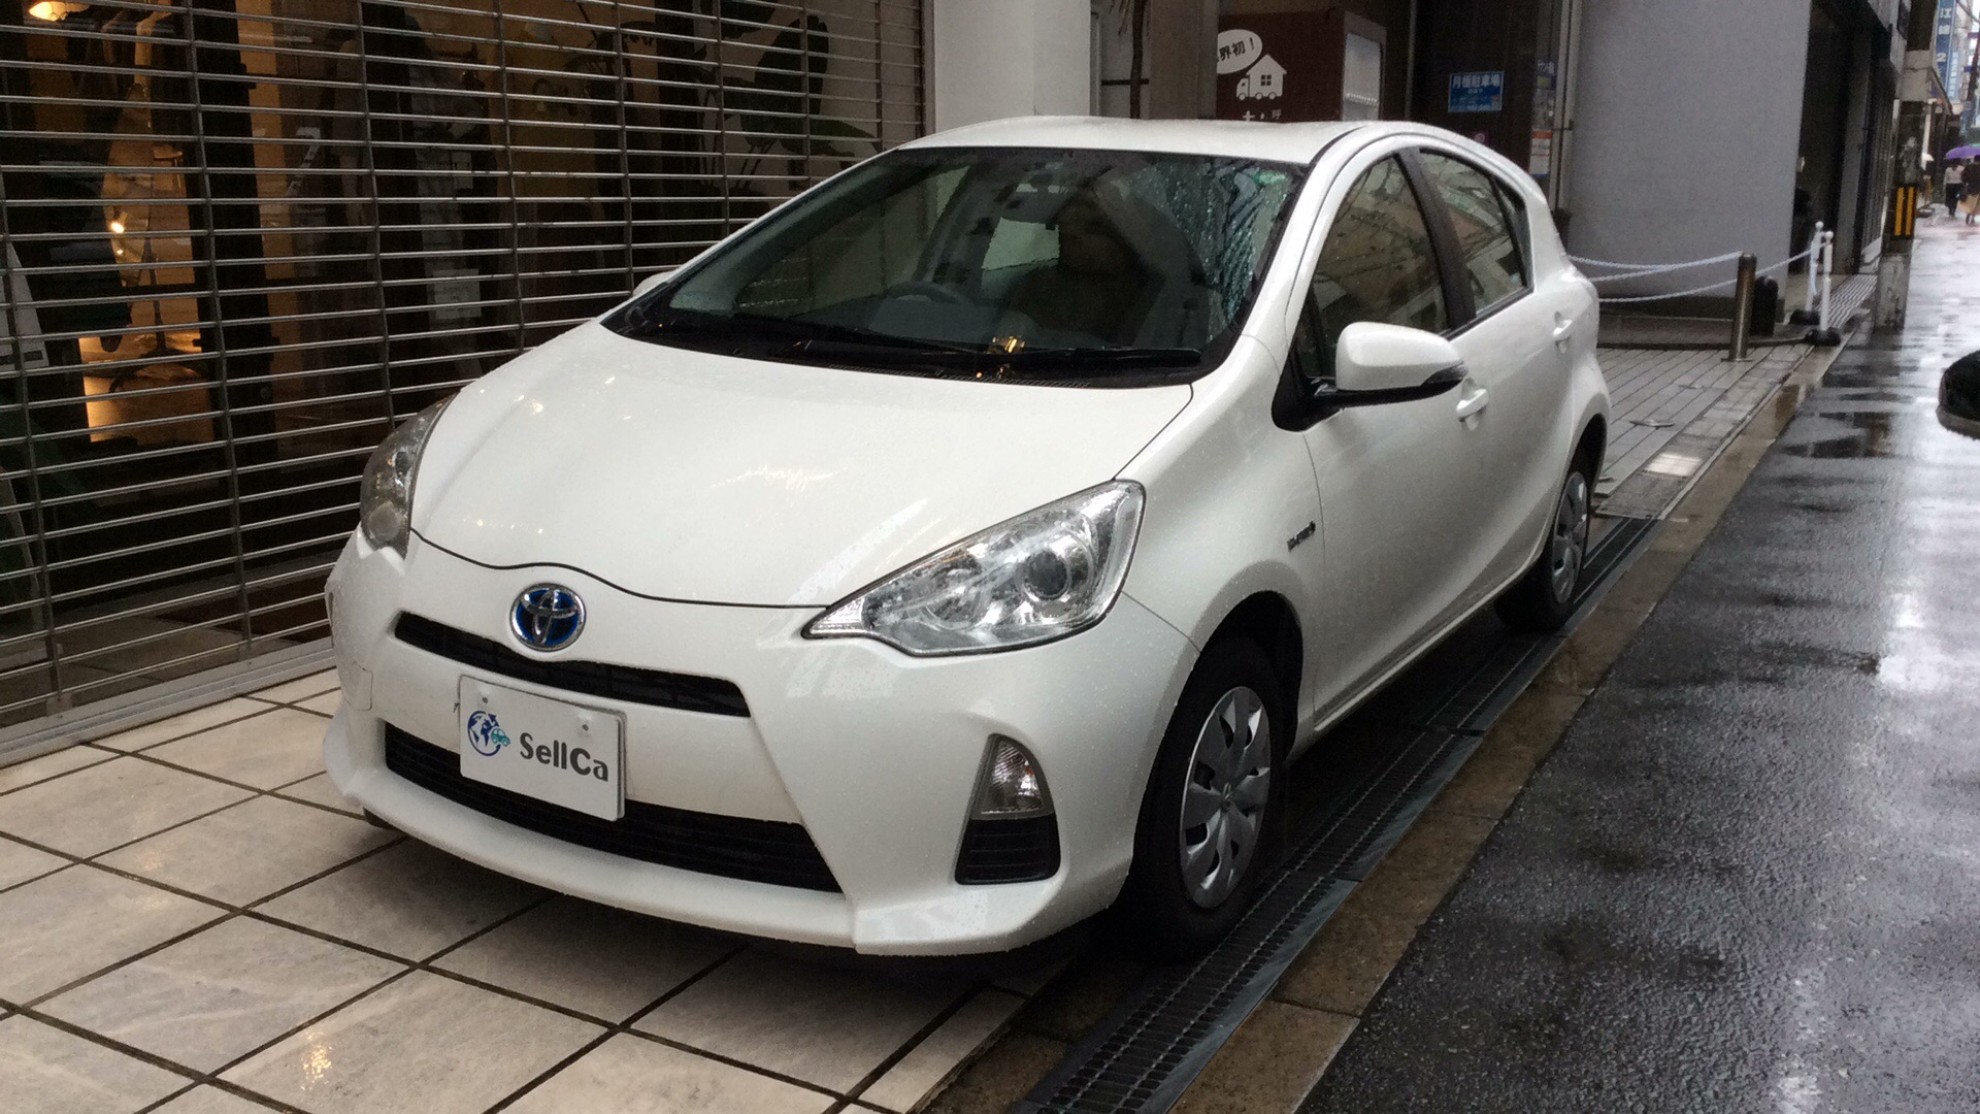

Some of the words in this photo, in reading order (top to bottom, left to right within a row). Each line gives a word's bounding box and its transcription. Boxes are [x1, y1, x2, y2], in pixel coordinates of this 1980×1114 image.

[1216, 37, 1254, 62] 界初！
[1452, 74, 1501, 88] 月極駐車場
[519, 732, 609, 782] SellCa
